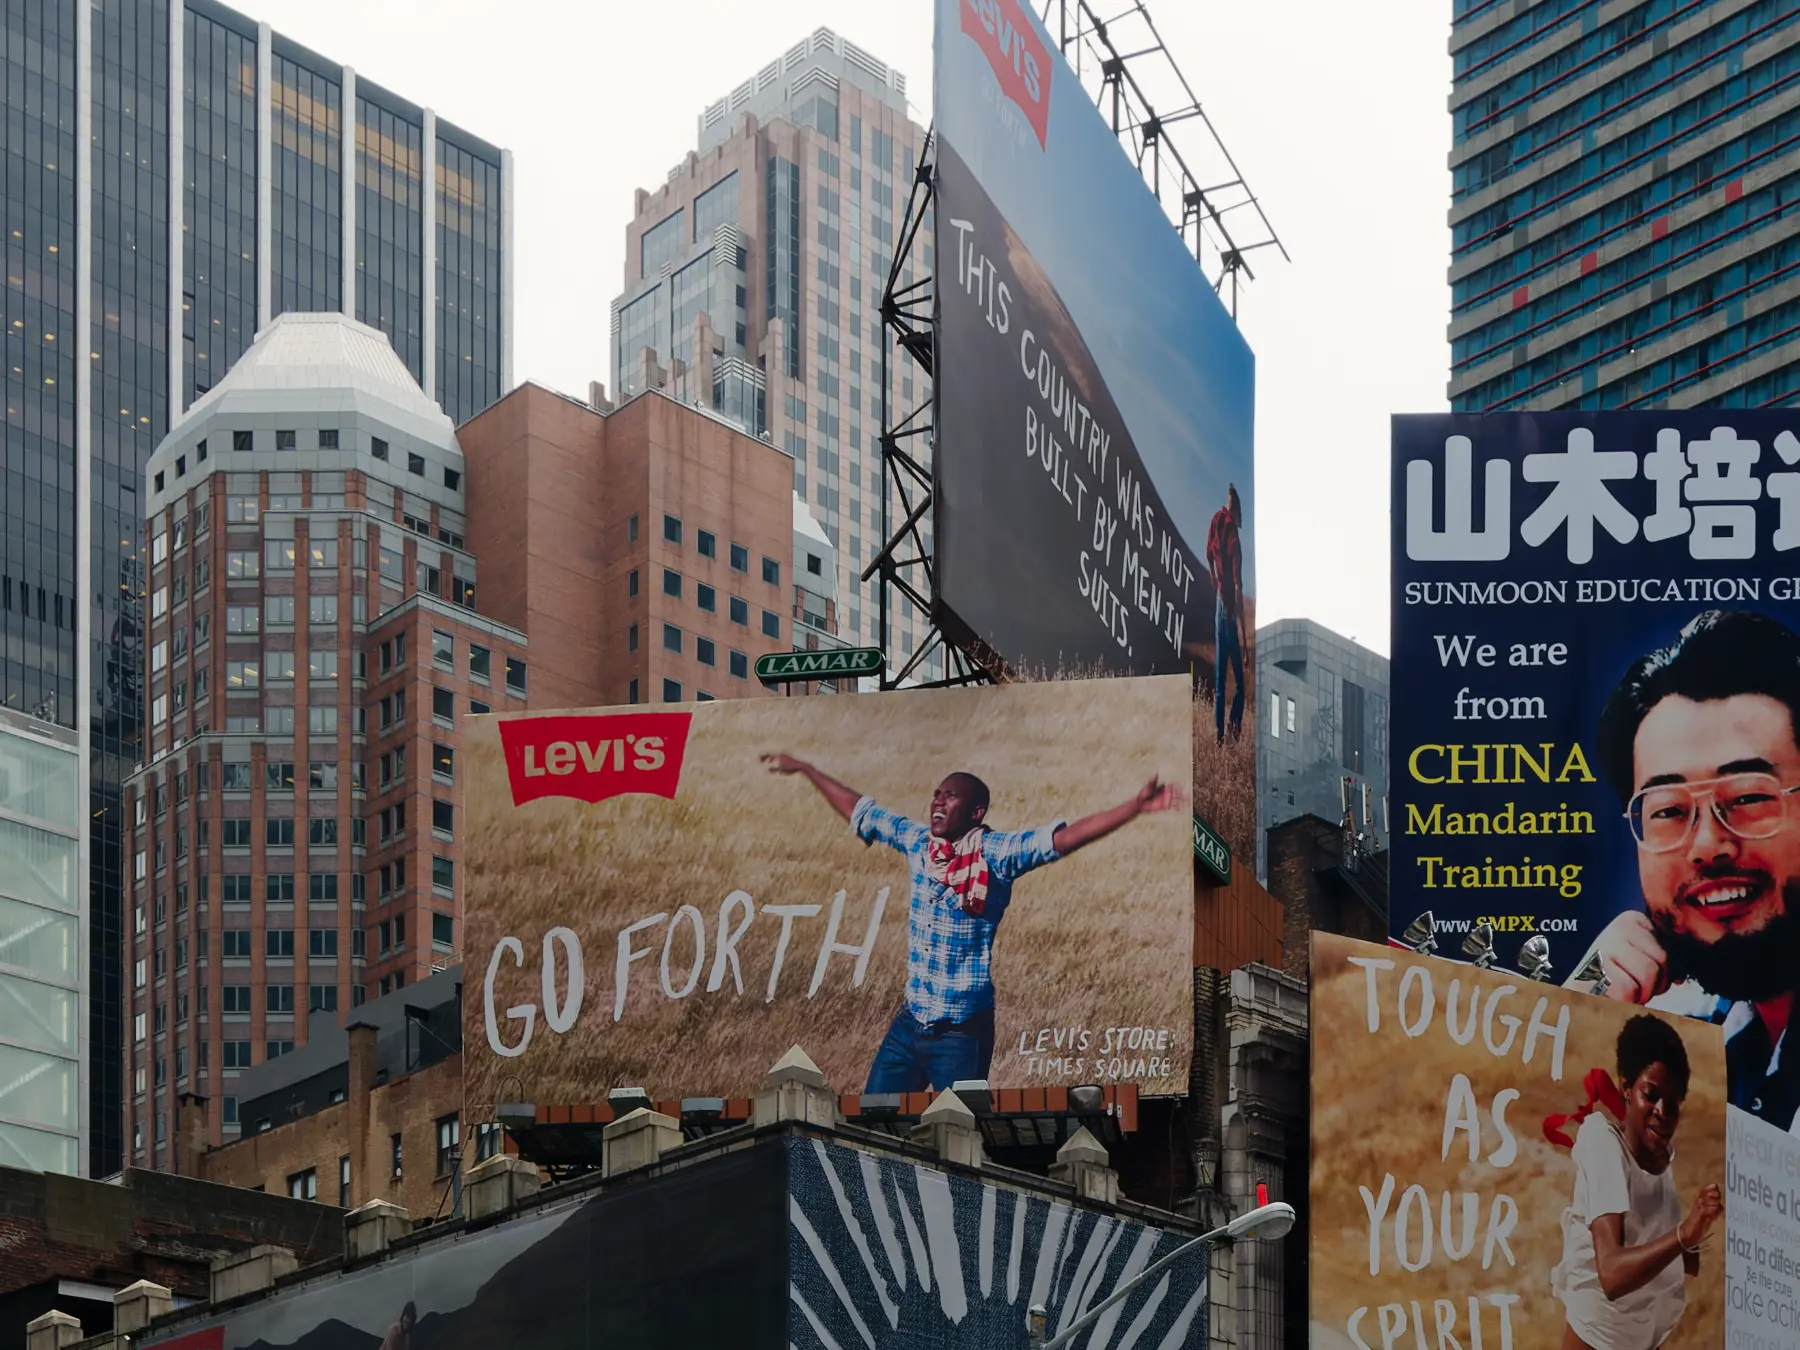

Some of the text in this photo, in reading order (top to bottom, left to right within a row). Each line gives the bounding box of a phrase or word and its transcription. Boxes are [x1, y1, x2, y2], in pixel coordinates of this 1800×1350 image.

[950, 217, 1013, 334] THIS
[1021, 328, 1195, 605] COUNTRY WAS NOT
[1026, 405, 1184, 658] BUILT BY MEN IN
[1078, 551, 1134, 656] SUITS.
[1405, 580, 1568, 605] SUNMOON
[1576, 578, 1762, 603] EDUCATION
[766, 651, 871, 674] LAMAR
[1434, 635, 1568, 667] We are
[1453, 688, 1547, 720] from
[524, 734, 666, 778] LeVI'S
[1408, 743, 1596, 784] CHINA
[1405, 802, 1596, 835] Mandarin
[1193, 827, 1225, 870] MAR
[1417, 857, 1583, 897] Training
[484, 887, 891, 1058] GO FORTH
[1348, 957, 1571, 1081] TOUGH
[1019, 1025, 1092, 1056] LEVI'S
[1027, 1057, 1171, 1080] TIMES SQUARE
[1441, 1073, 1519, 1168] AS
[1727, 1115, 1772, 1167] Wear
[1776, 1190, 1787, 1216] a
[1358, 1172, 1519, 1277] YOUR
[1727, 1226, 1752, 1260] Haz
[1754, 1238, 1766, 1266] la
[1725, 1274, 1764, 1317] Take
[1746, 1265, 1793, 1298] Be the cure
